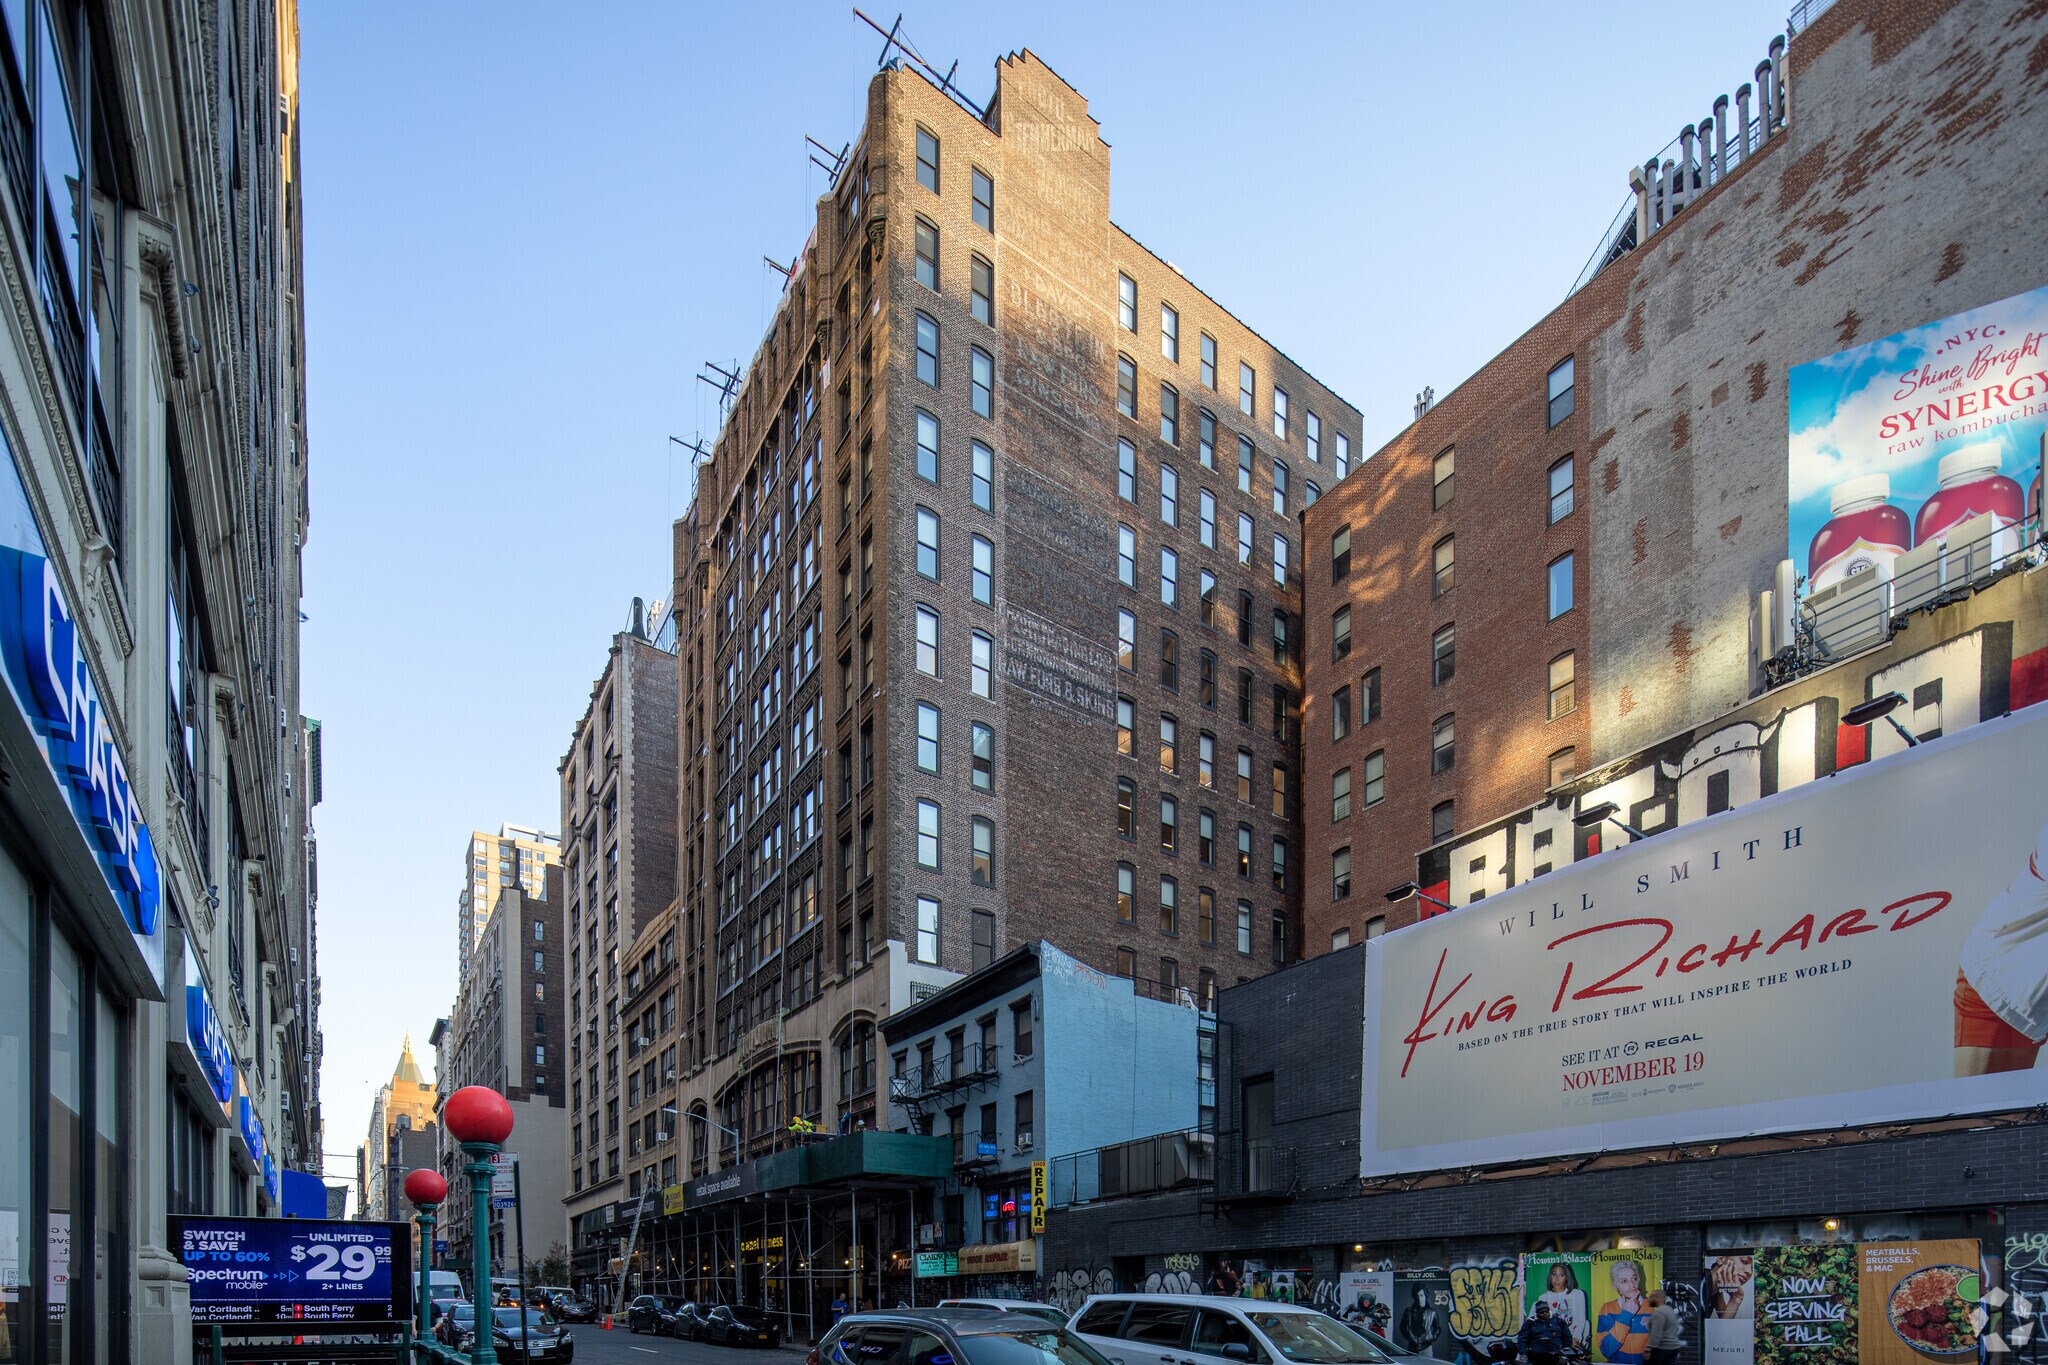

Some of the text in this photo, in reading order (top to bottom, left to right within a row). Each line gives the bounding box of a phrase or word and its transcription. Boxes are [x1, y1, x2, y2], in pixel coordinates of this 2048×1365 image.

[1944, 325, 1996, 350] NYC
[1893, 331, 2048, 401] Shine Bright
[1938, 378, 1964, 394] with
[1879, 369, 2048, 440] SYNERGY
[1887, 400, 2048, 455] raw kombucha
[43, 557, 142, 893] CHASE
[1498, 826, 1803, 936] WILL SMITH
[1401, 891, 1952, 1078] KING RICHARD
[1458, 958, 1852, 1051] BASED ON THE TRUE STORY THAT WILL INSPIRE THE WORLD
[1562, 1052, 1585, 1067] SEE
[1588, 1050, 1601, 1062] IT
[1603, 1046, 1619, 1059] AT
[1645, 1033, 1703, 1049] REGAL
[1562, 1051, 1705, 1092] NOVEMBER 19
[493, 1154, 499, 1163] 3
[964, 1176, 971, 1184] P
[1034, 1168, 1044, 1226] REPAIR
[1002, 1204, 1015, 1212] OPEN
[183, 1230, 246, 1241] SWITCH
[309, 1233, 374, 1243] UNLIMITED
[183, 1241, 239, 1251] & SAVE
[374, 1246, 392, 1256] 99
[1865, 1247, 1920, 1257] MEATBALLS,
[184, 1252, 270, 1262] UP TO 60%
[984, 1252, 1008, 1263] REPAIR
[1591, 1250, 1630, 1266] Rowing
[1865, 1256, 1914, 1265] BRUSSELS,
[187, 1267, 263, 1283] Spectrum
[1874, 1264, 1893, 1272] MAC
[1781, 1276, 1827, 1295] NOW
[189, 1304, 292, 1313] Van Cortlandt 5m
[304, 1304, 330, 1312] South
[331, 1304, 354, 1313] Ferry
[1764, 1300, 1847, 1321] SERVING
[1784, 1324, 1832, 1342] FALL
